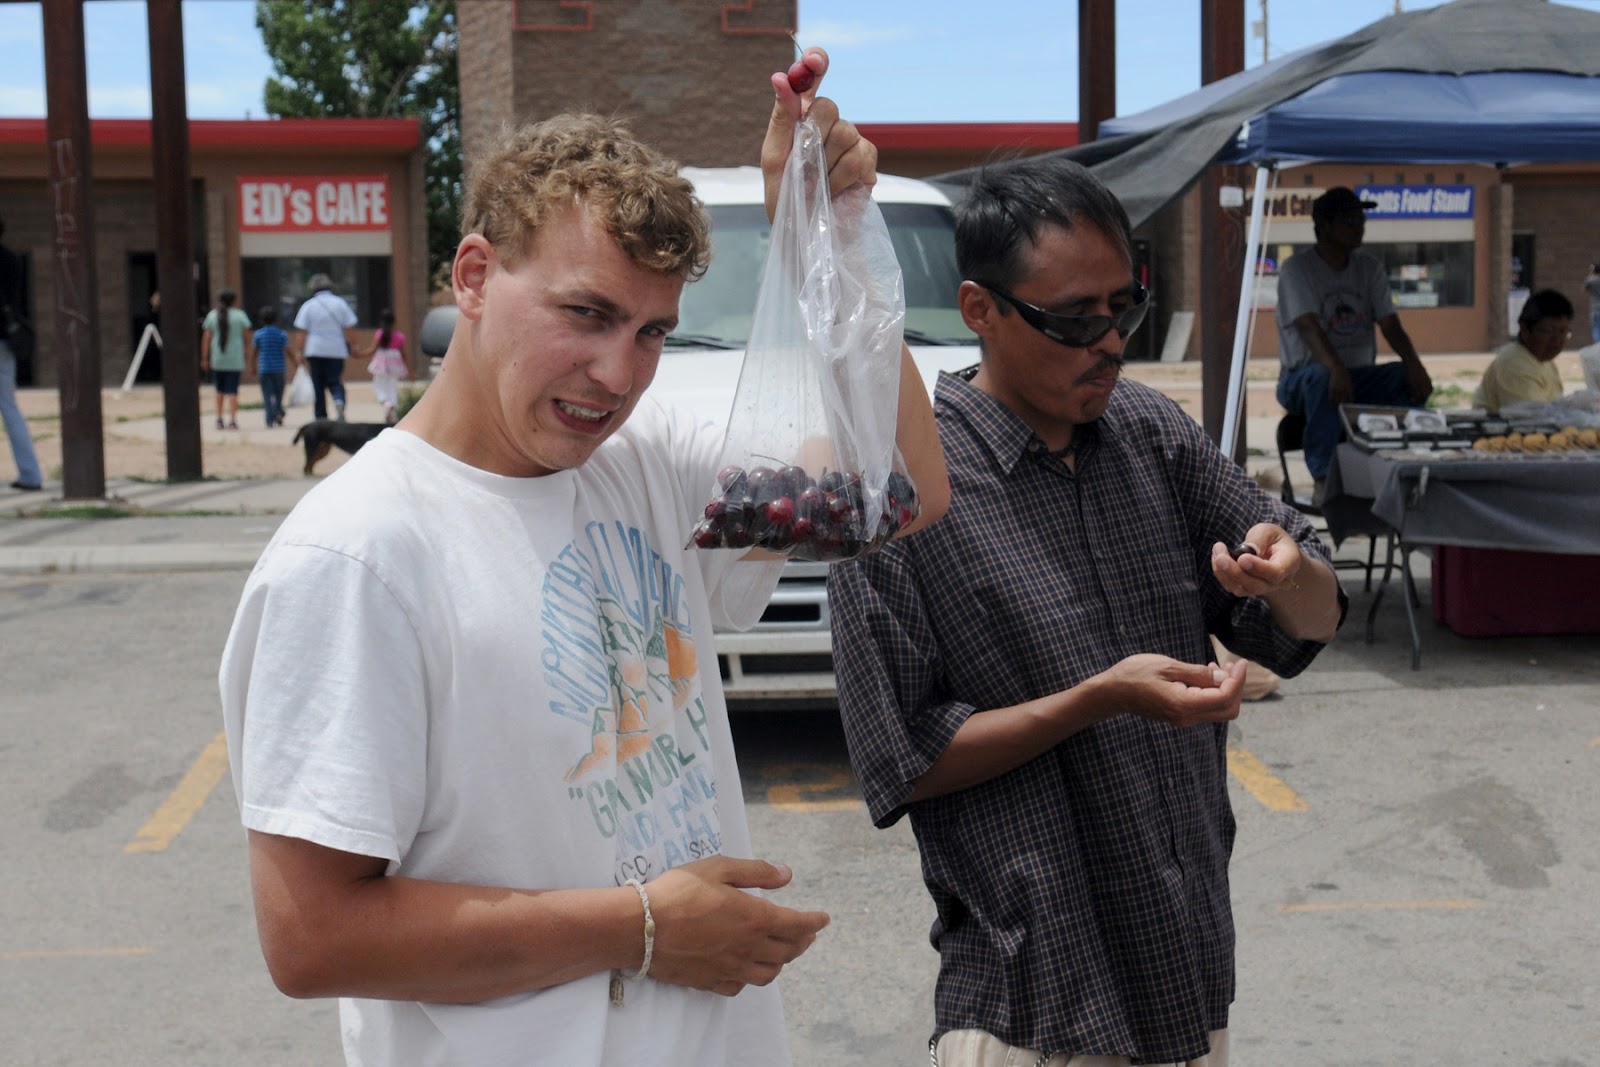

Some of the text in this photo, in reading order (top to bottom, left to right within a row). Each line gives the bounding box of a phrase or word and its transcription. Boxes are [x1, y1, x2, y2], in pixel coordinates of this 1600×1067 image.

[241, 182, 388, 226] ED's CAFE
[1401, 188, 1433, 213] Food
[1432, 188, 1471, 213] Stand
